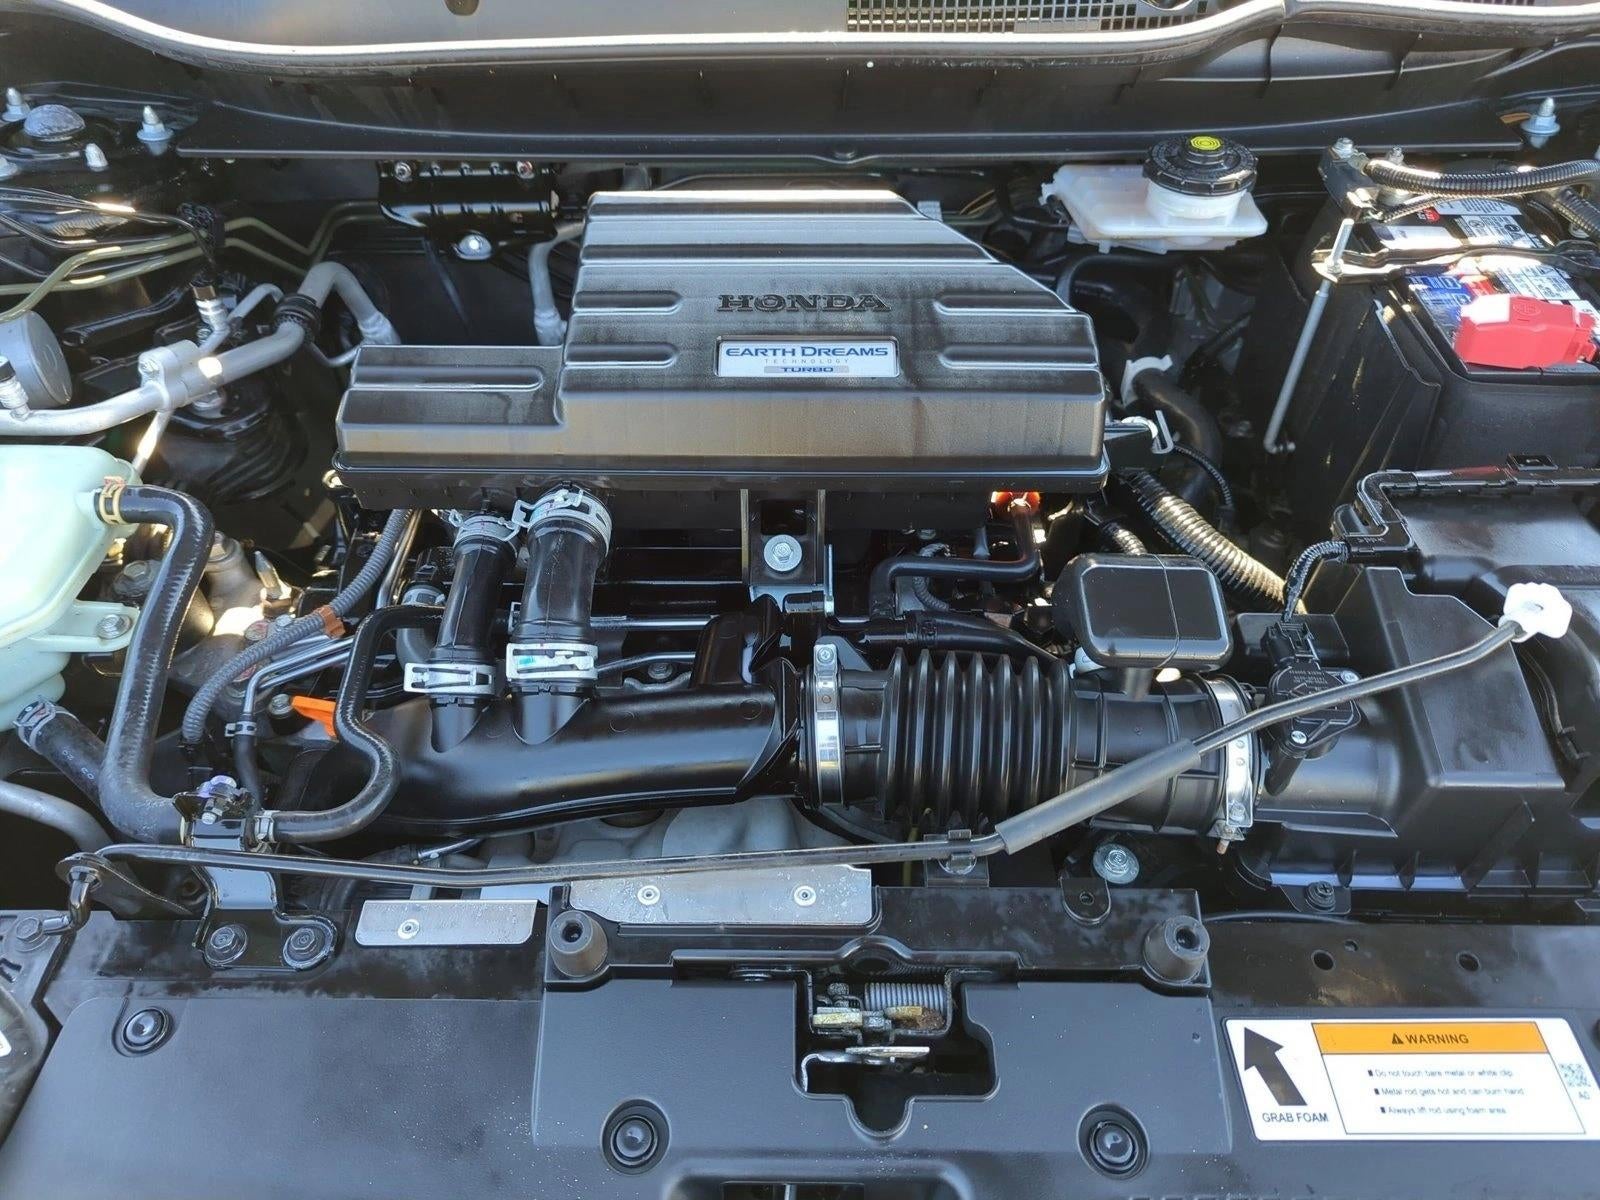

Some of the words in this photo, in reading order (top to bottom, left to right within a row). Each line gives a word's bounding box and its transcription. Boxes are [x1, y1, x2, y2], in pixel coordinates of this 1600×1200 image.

[717, 294, 892, 313] HONDA
[725, 347, 796, 357] EARTH
[801, 346, 889, 357] DREAMS
[1405, 1033, 1469, 1045] WARNING
[1262, 1112, 1294, 1123] GRAB
[1296, 1112, 1329, 1123] FOAM
